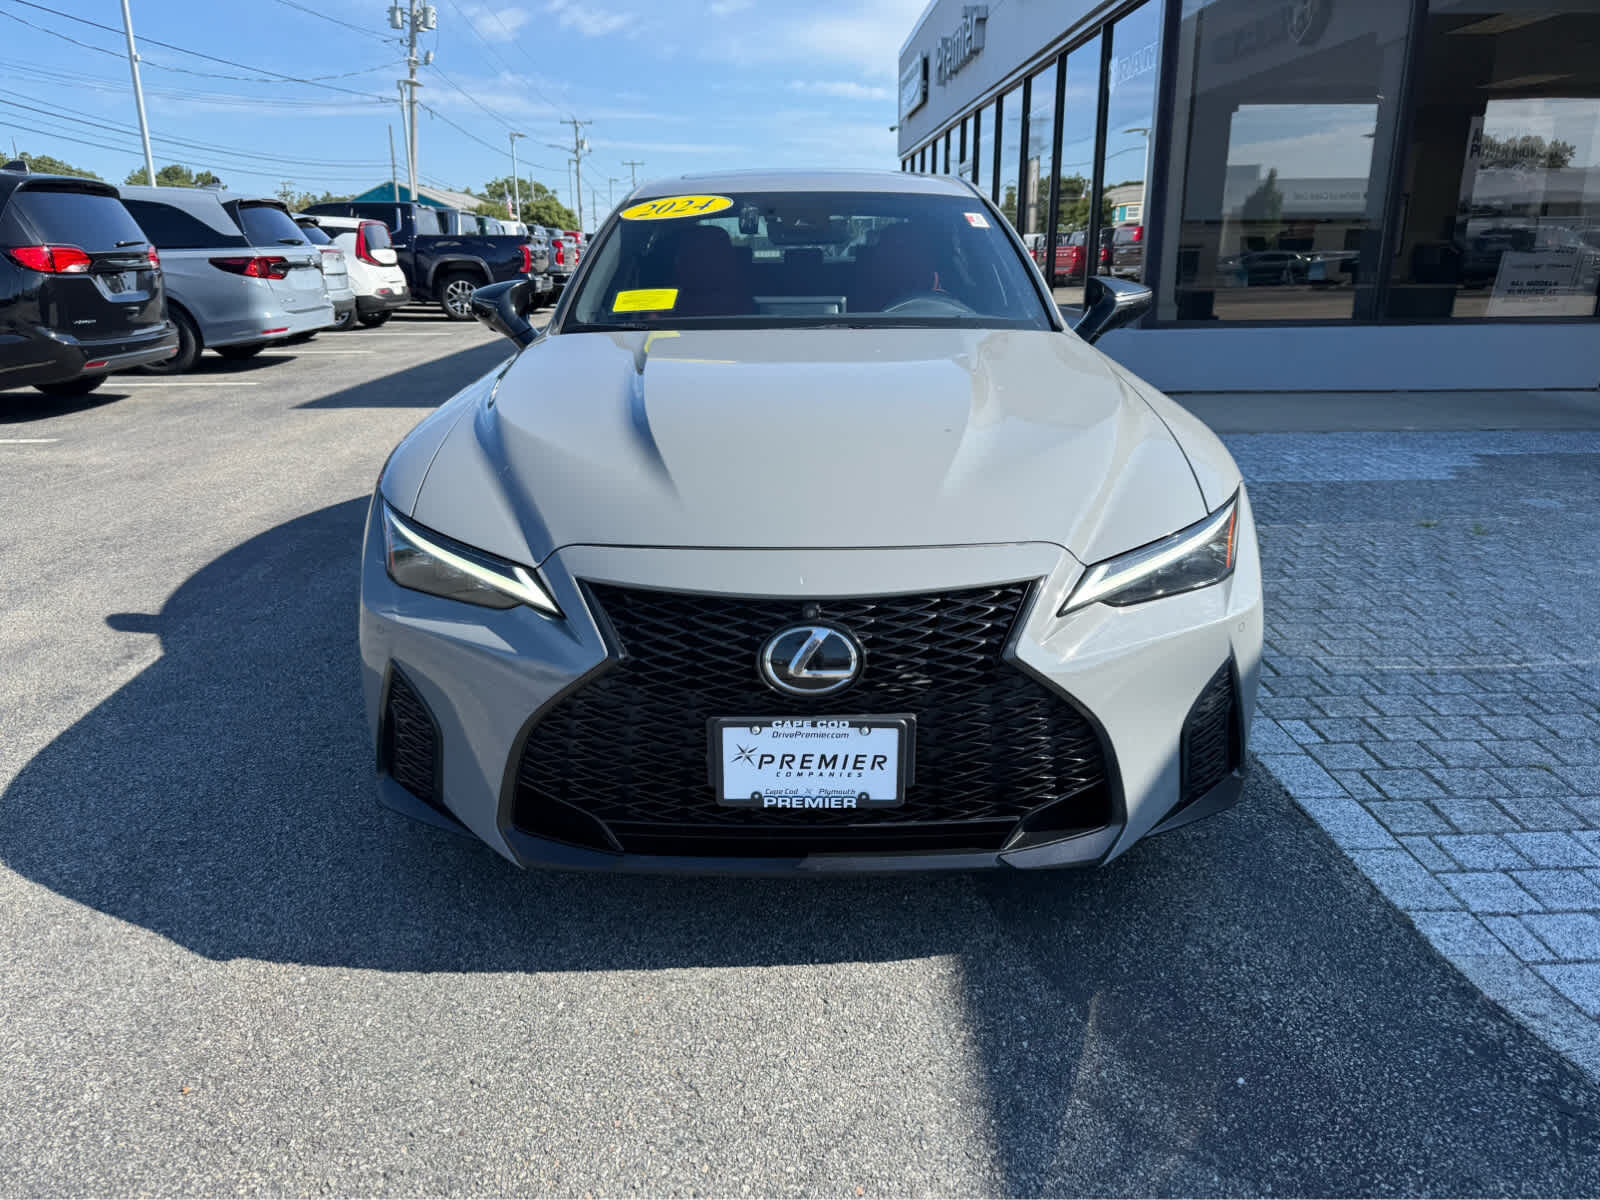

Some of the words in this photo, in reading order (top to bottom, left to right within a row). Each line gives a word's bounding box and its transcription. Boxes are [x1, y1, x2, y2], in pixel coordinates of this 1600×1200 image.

[637, 198, 717, 217] 2024
[772, 720, 812, 729] CAPE
[816, 720, 850, 729] COD
[771, 730, 850, 739] DrivePremier.com
[757, 753, 888, 771] PREMIER
[818, 788, 856, 797] Plymouth
[763, 796, 857, 809] PREMIER
